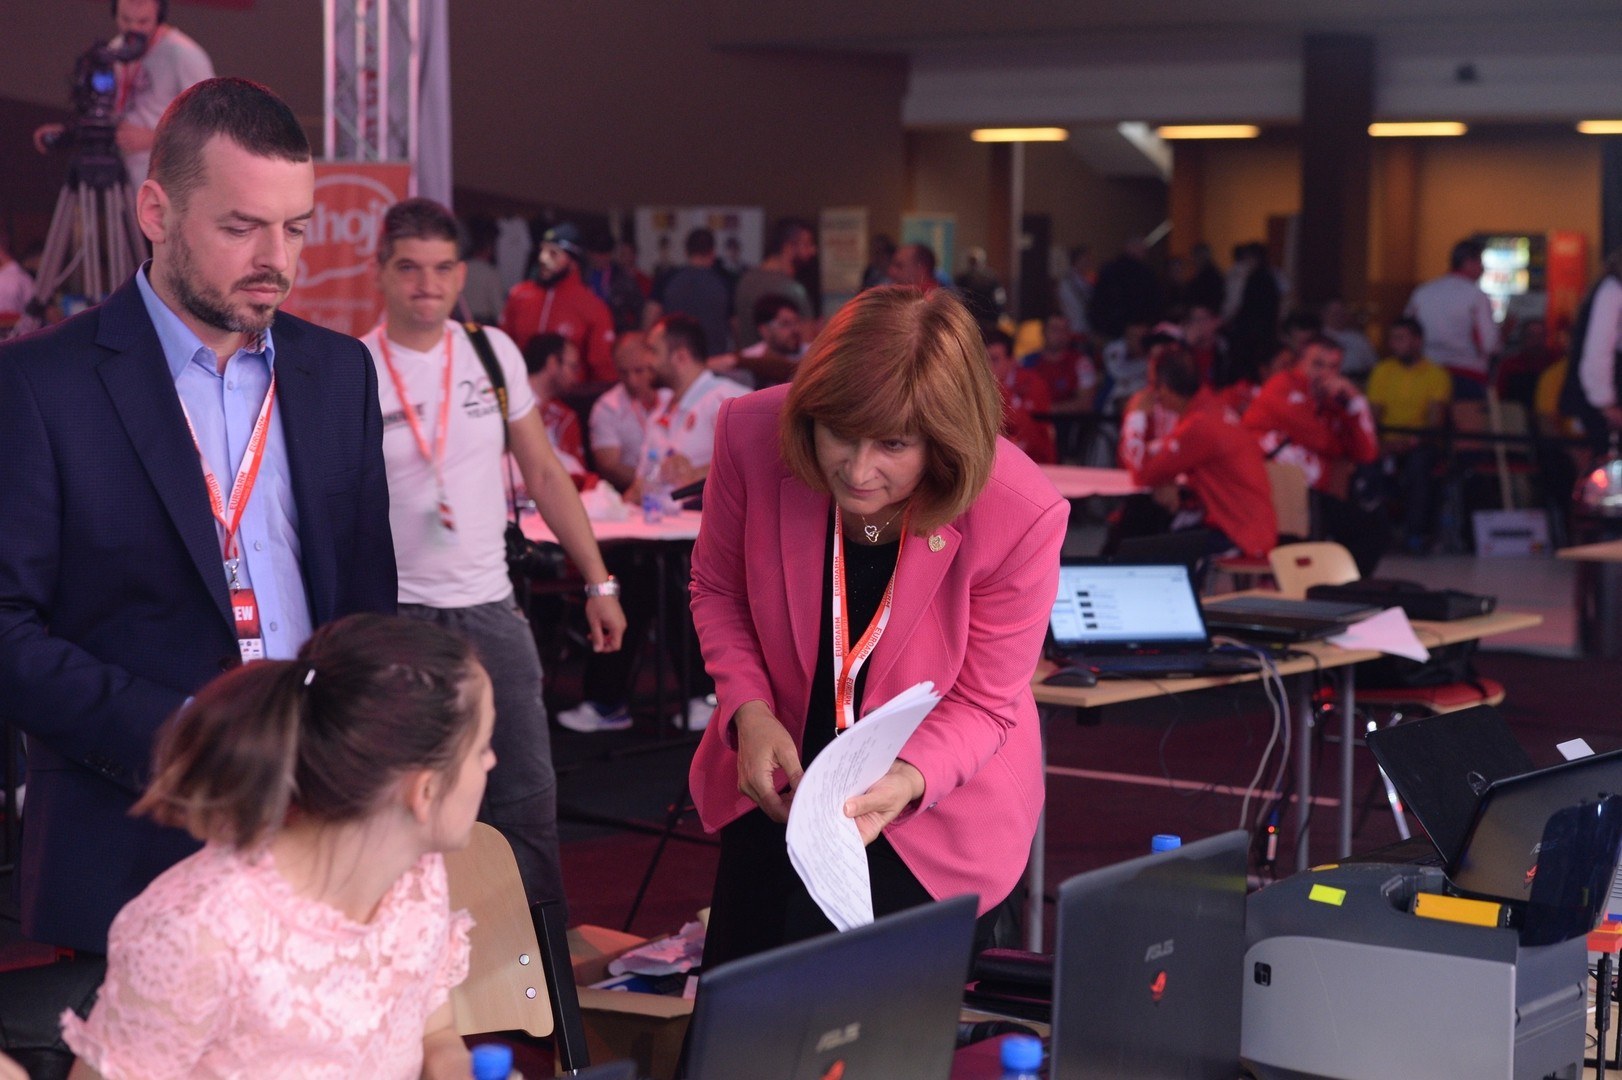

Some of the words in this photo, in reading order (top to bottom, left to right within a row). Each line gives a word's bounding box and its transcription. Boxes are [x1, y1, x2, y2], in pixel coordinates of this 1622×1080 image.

[249, 415, 265, 452] EUROARM
[206, 472, 224, 513] EUROARM
[230, 471, 247, 510] EUROARM
[232, 606, 253, 621] EW
[858, 627, 882, 660] EUROARM
